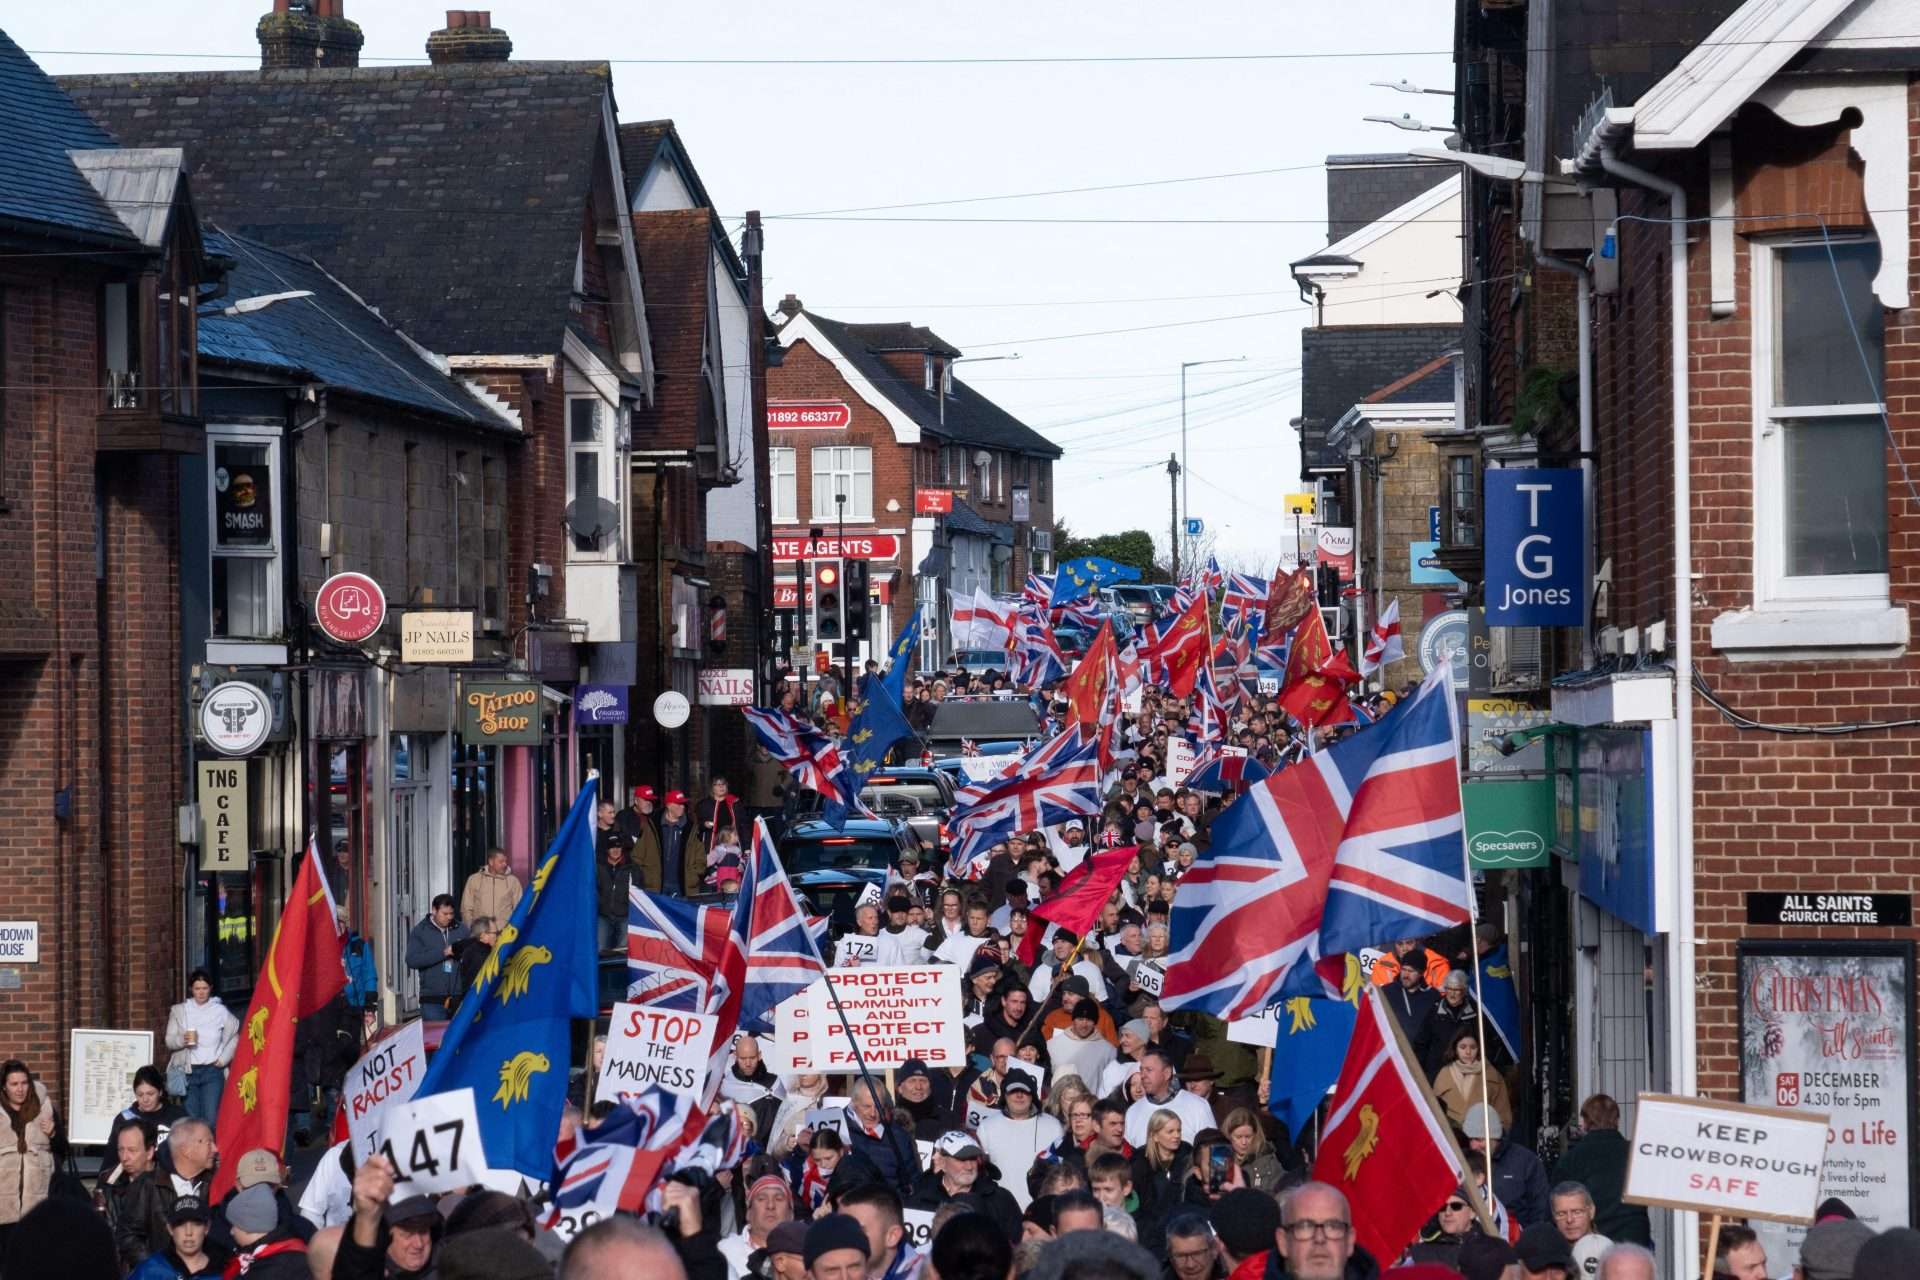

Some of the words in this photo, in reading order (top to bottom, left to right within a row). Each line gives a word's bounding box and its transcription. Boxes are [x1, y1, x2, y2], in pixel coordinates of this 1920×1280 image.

[801, 411, 842, 422] 663377
[1516, 484, 1552, 527] T
[225, 512, 264, 528] SMASH
[1190, 522, 1197, 531] P
[804, 540, 872, 554] AGENTS
[1515, 534, 1553, 579] G
[1498, 584, 1571, 611] Jones
[405, 631, 422, 644] JP
[426, 631, 470, 643] NAILS
[699, 680, 752, 695] NAILS
[468, 689, 536, 721] TATTOO
[731, 697, 752, 705] BAR
[481, 713, 529, 735] SHOP
[206, 769, 238, 788] TN6
[216, 795, 230, 862] CAFE
[1475, 841, 1537, 852] Specsavers
[1784, 896, 1812, 910] ALL
[1816, 896, 1873, 911] SAINTS
[1779, 911, 1829, 923] CHURCH
[1831, 912, 1878, 924] CENTRE
[846, 941, 874, 957] 172
[828, 971, 943, 987] PROTECT
[1136, 970, 1159, 992] 505
[864, 986, 904, 997] OUR
[826, 997, 942, 1010] COMMUNITY
[865, 1009, 907, 1020] AND
[623, 1010, 702, 1046] STOP
[828, 1021, 945, 1037] PROTECT
[867, 1037, 907, 1047] OUR
[646, 1041, 676, 1061] THE
[829, 1048, 946, 1064] FAMILIES
[362, 1044, 396, 1086] NOT
[606, 1058, 695, 1089] MADNESS
[1780, 1076, 1795, 1086] SAT
[1803, 1072, 1880, 1088] DECEMBER
[353, 1055, 416, 1121] RACIST
[1779, 1087, 1798, 1105] 06
[1803, 1092, 1830, 1106] 4.30
[1833, 1092, 1850, 1106] for
[1853, 1093, 1881, 1110] 5pm
[1697, 1122, 1769, 1145] KEEP
[1842, 1128, 1855, 1145] a
[1862, 1120, 1897, 1145] Life
[380, 1119, 464, 1183] 147
[1639, 1143, 1817, 1177] CROWBOROUGH
[1857, 1161, 1866, 1169] to
[1689, 1174, 1760, 1197] SAFE
[1828, 1173, 1848, 1183] lives
[1850, 1172, 1859, 1183] of
[1861, 1173, 1887, 1184] loved
[1824, 1187, 1870, 1198] remember
